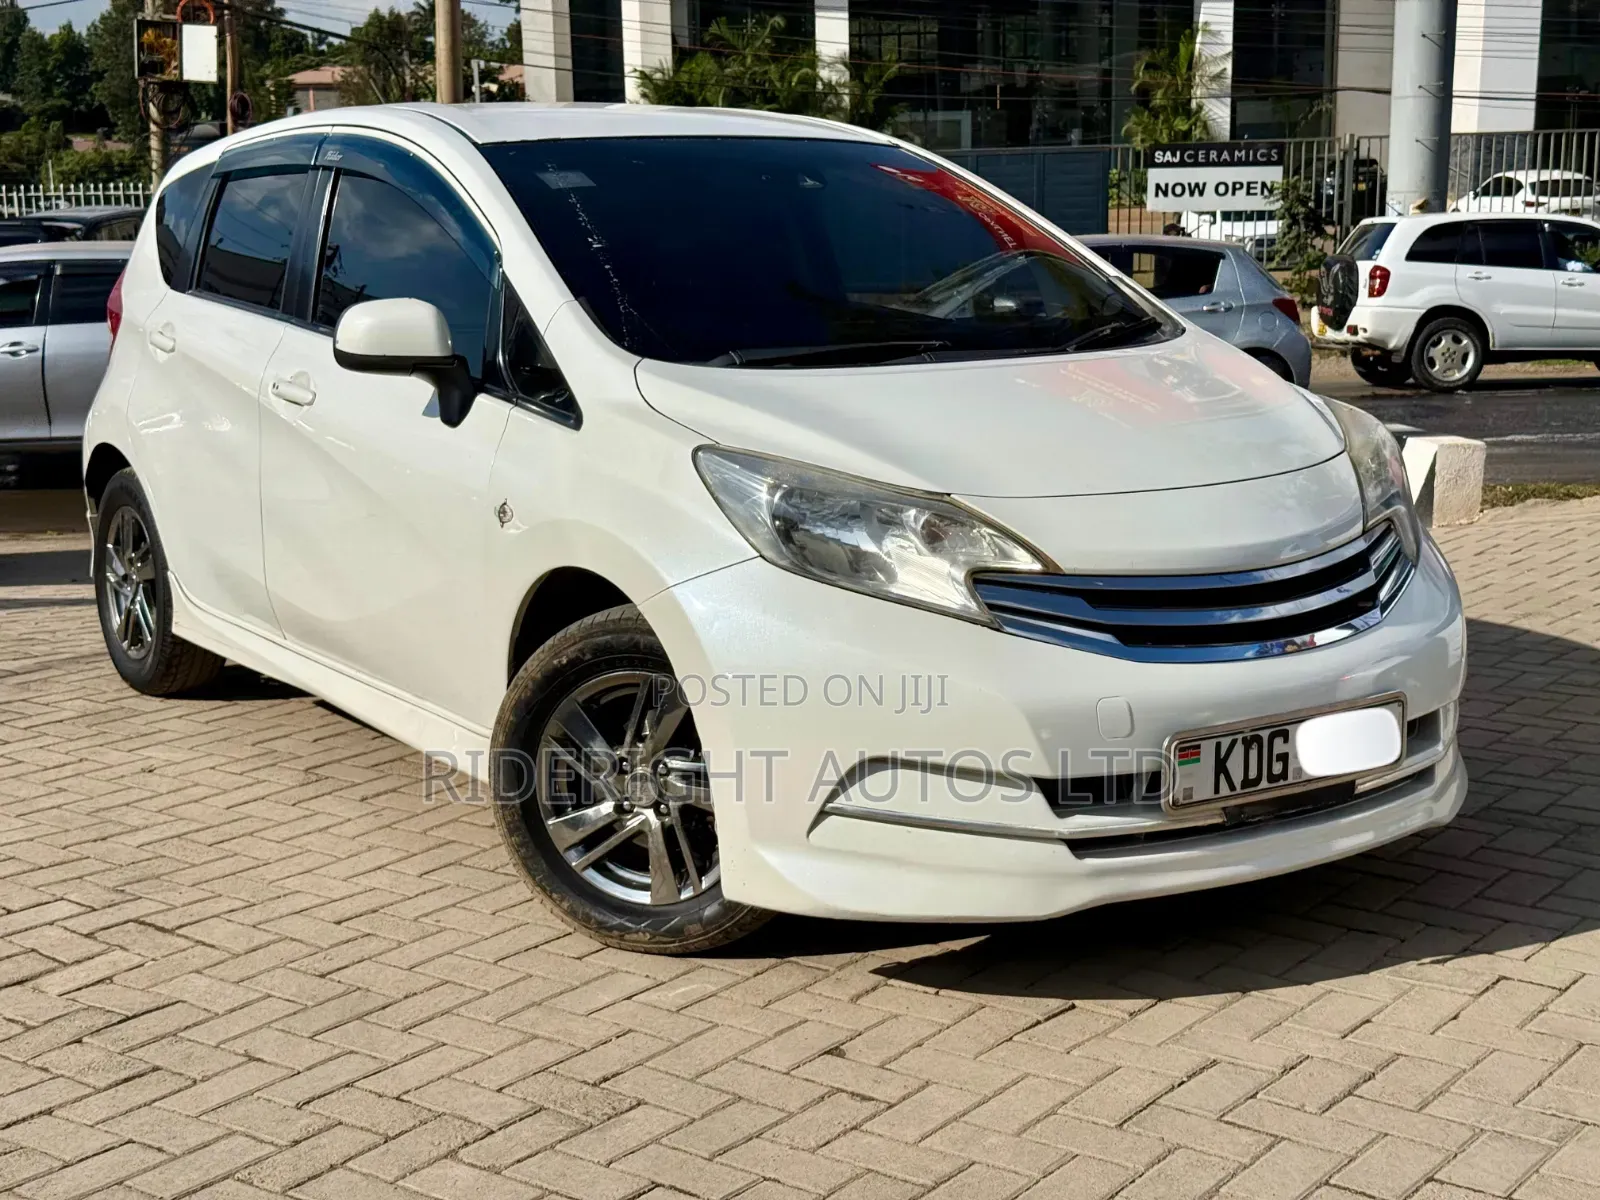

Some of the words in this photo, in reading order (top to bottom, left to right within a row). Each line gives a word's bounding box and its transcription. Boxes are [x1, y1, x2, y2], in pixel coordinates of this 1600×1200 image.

[1154, 150, 1181, 164] SAJ
[1183, 148, 1279, 163] CERAMICS
[1154, 181, 1207, 198] NOW
[1214, 180, 1275, 197] OPEN
[1213, 728, 1290, 795] KDG
